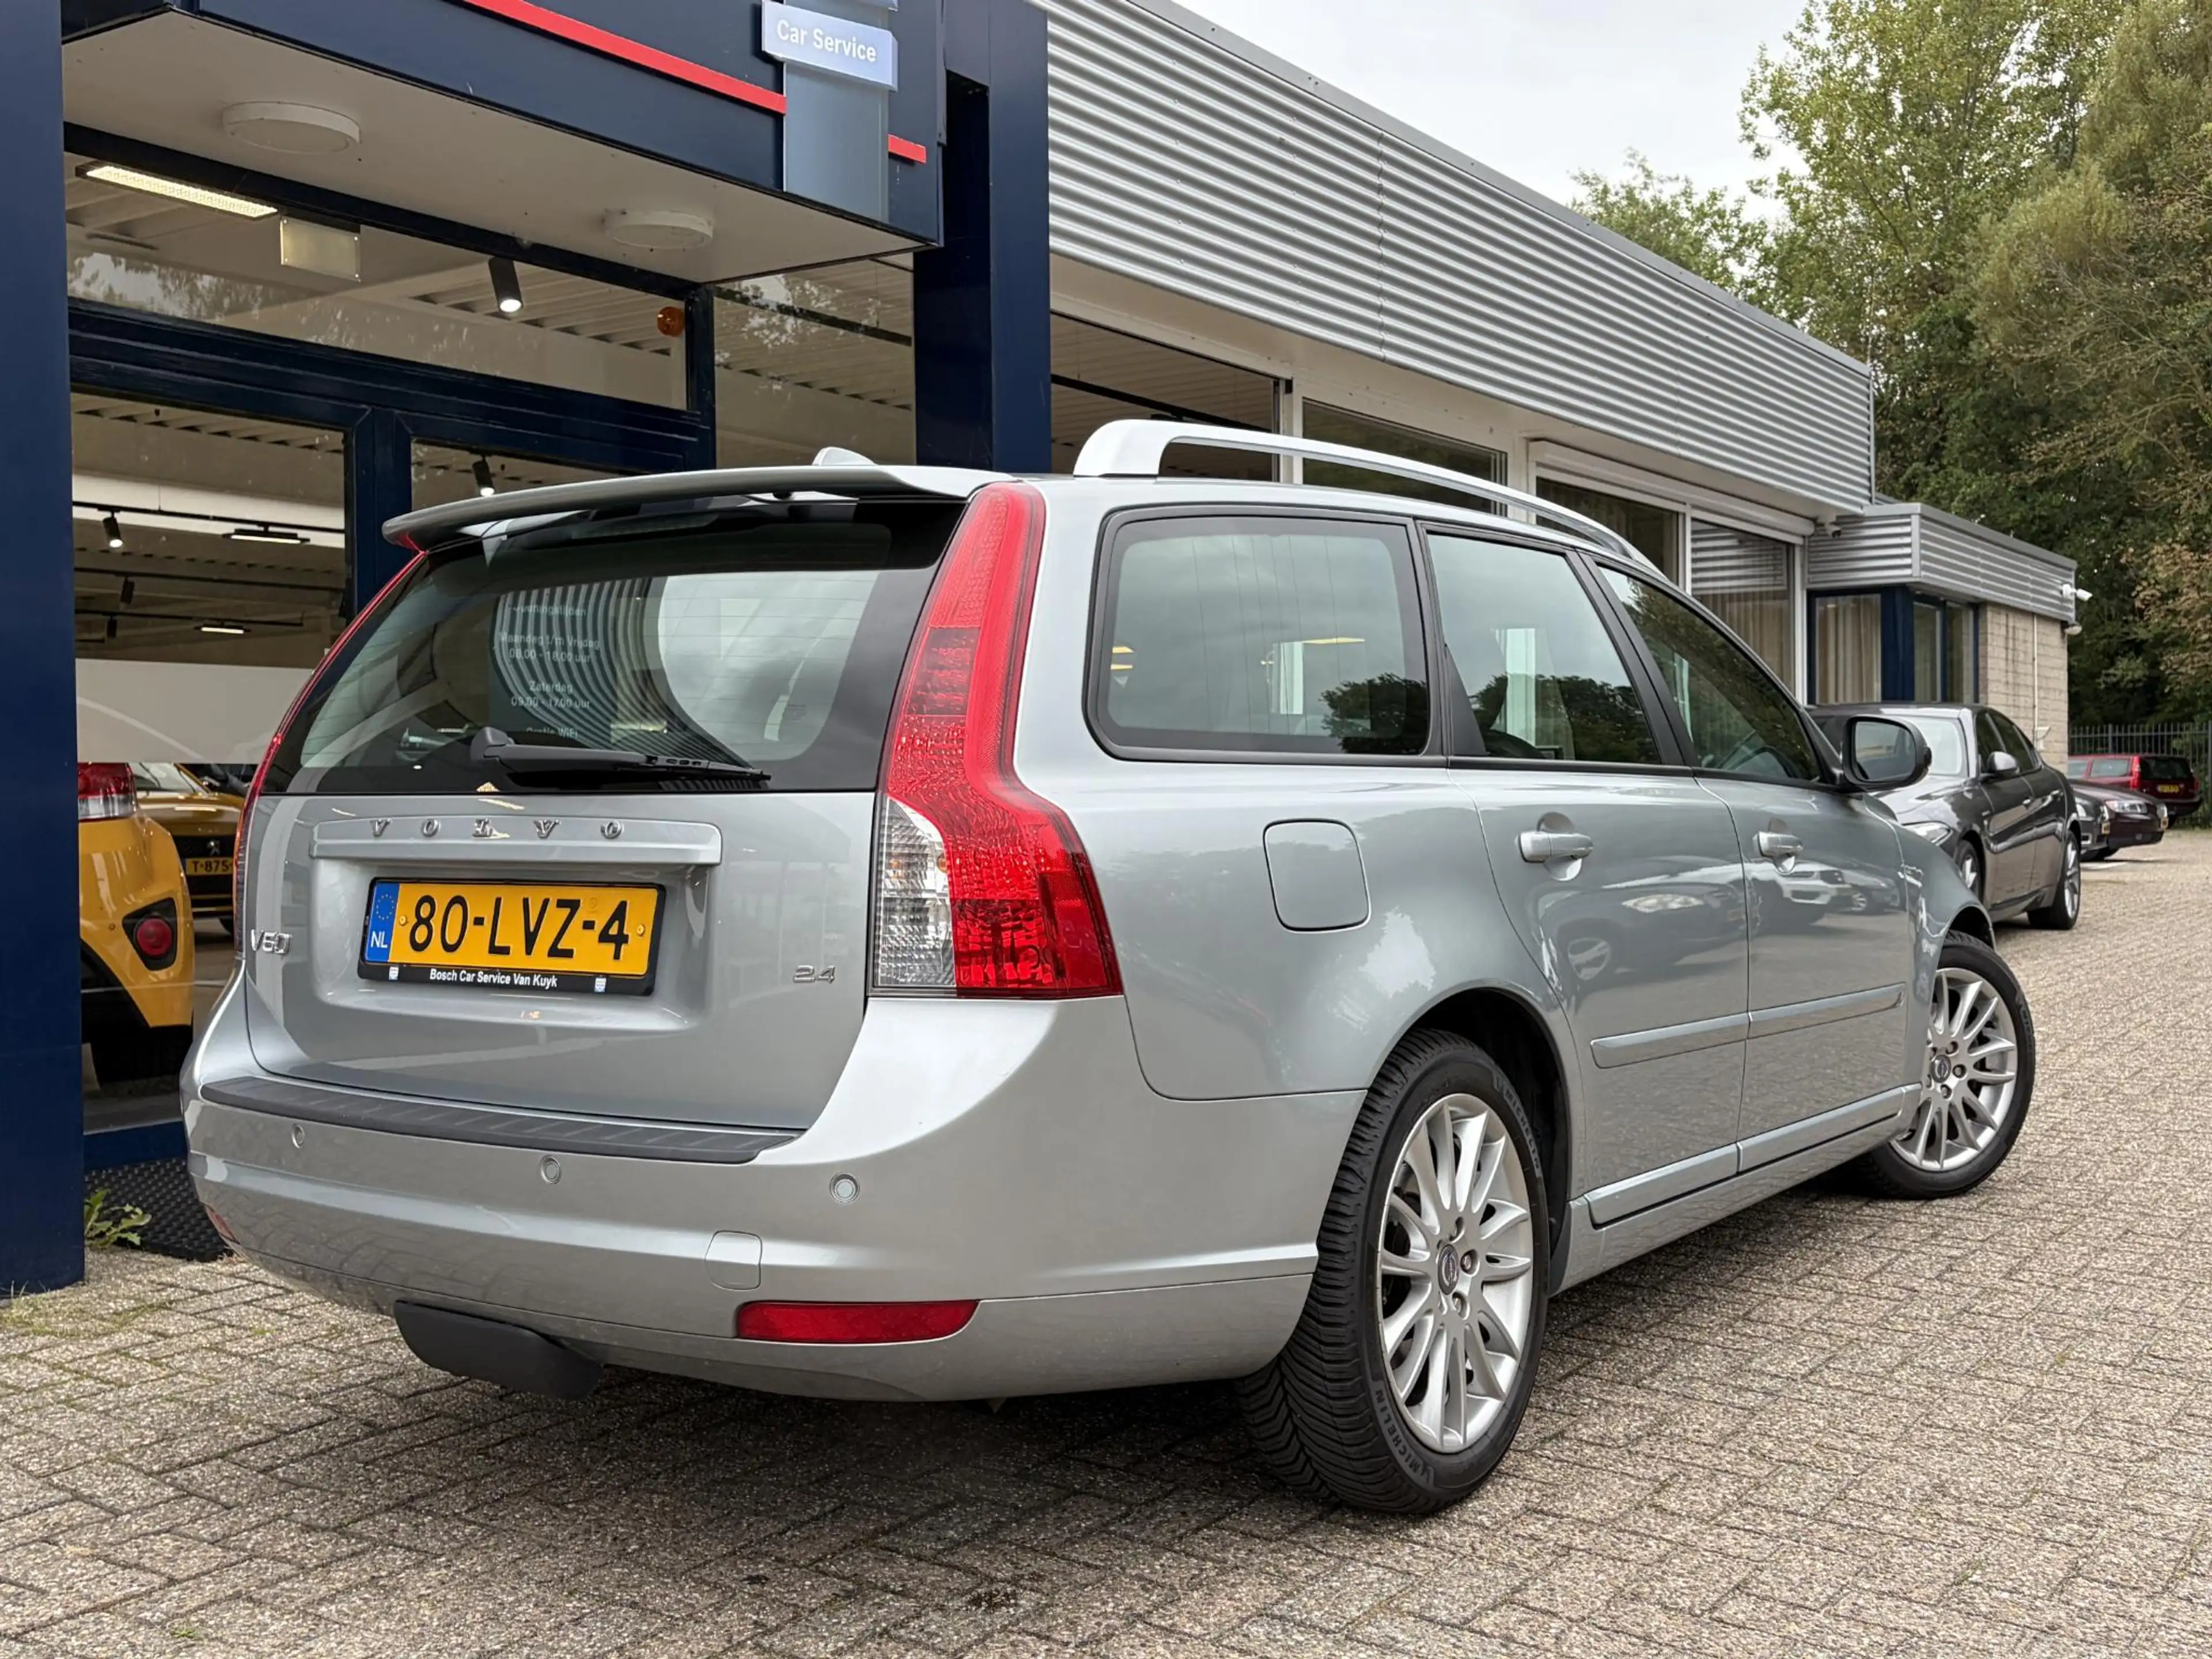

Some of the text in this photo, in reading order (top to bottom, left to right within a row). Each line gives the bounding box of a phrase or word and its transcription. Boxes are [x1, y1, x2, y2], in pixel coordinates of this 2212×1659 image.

[777, 19, 877, 62] Car Service
[370, 818, 624, 839] VOLVO
[192, 859, 232, 873] T-875-
[408, 894, 630, 961] 80-LVZ-4
[251, 929, 292, 955] V50
[370, 931, 388, 950] NL
[429, 968, 558, 990] Bosch Car Service Van Kuyk
[1375, 1389, 1421, 1474] MICHELIN
